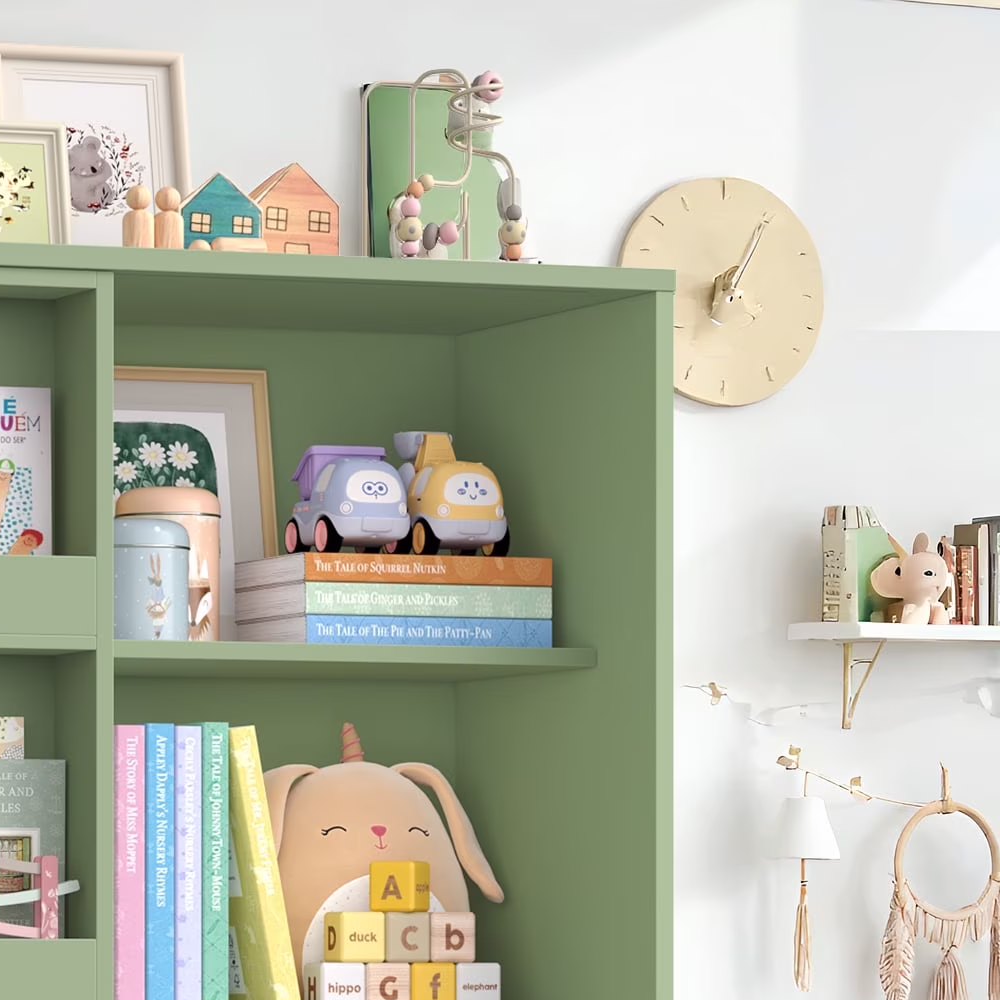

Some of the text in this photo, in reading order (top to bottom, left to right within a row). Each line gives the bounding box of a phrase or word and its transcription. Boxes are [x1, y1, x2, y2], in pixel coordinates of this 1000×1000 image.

[314, 559, 446, 575] THE TALE OF SQUIRREL NUTKIN
[315, 590, 335, 604] THE
[336, 591, 358, 604] TALE
[370, 592, 404, 606] GINGER
[405, 594, 424, 606] AND
[424, 593, 458, 606] PICKLES
[316, 622, 492, 640] THE TALE OF THE PIE AND THE PATTY-PAN
[156, 735, 168, 771] APPLEY
[15, 772, 28, 781] OF
[8, 786, 34, 797] AND
[126, 736, 138, 873] THE STORY OF MISS MOPPET
[209, 734, 223, 911] THE TALE OF JOHNNY TOWN-MOUSE
[156, 820, 168, 865] NURSERY
[184, 824, 196, 868] NURSERY
[156, 867, 168, 907] RHYMES
[381, 874, 402, 900] A
[327, 926, 336, 951] D
[349, 931, 377, 943] duck
[445, 923, 465, 950] b
[328, 982, 361, 996] hippo
[379, 976, 398, 1000] G
[429, 972, 441, 1000] f
[462, 983, 498, 992] elephant
